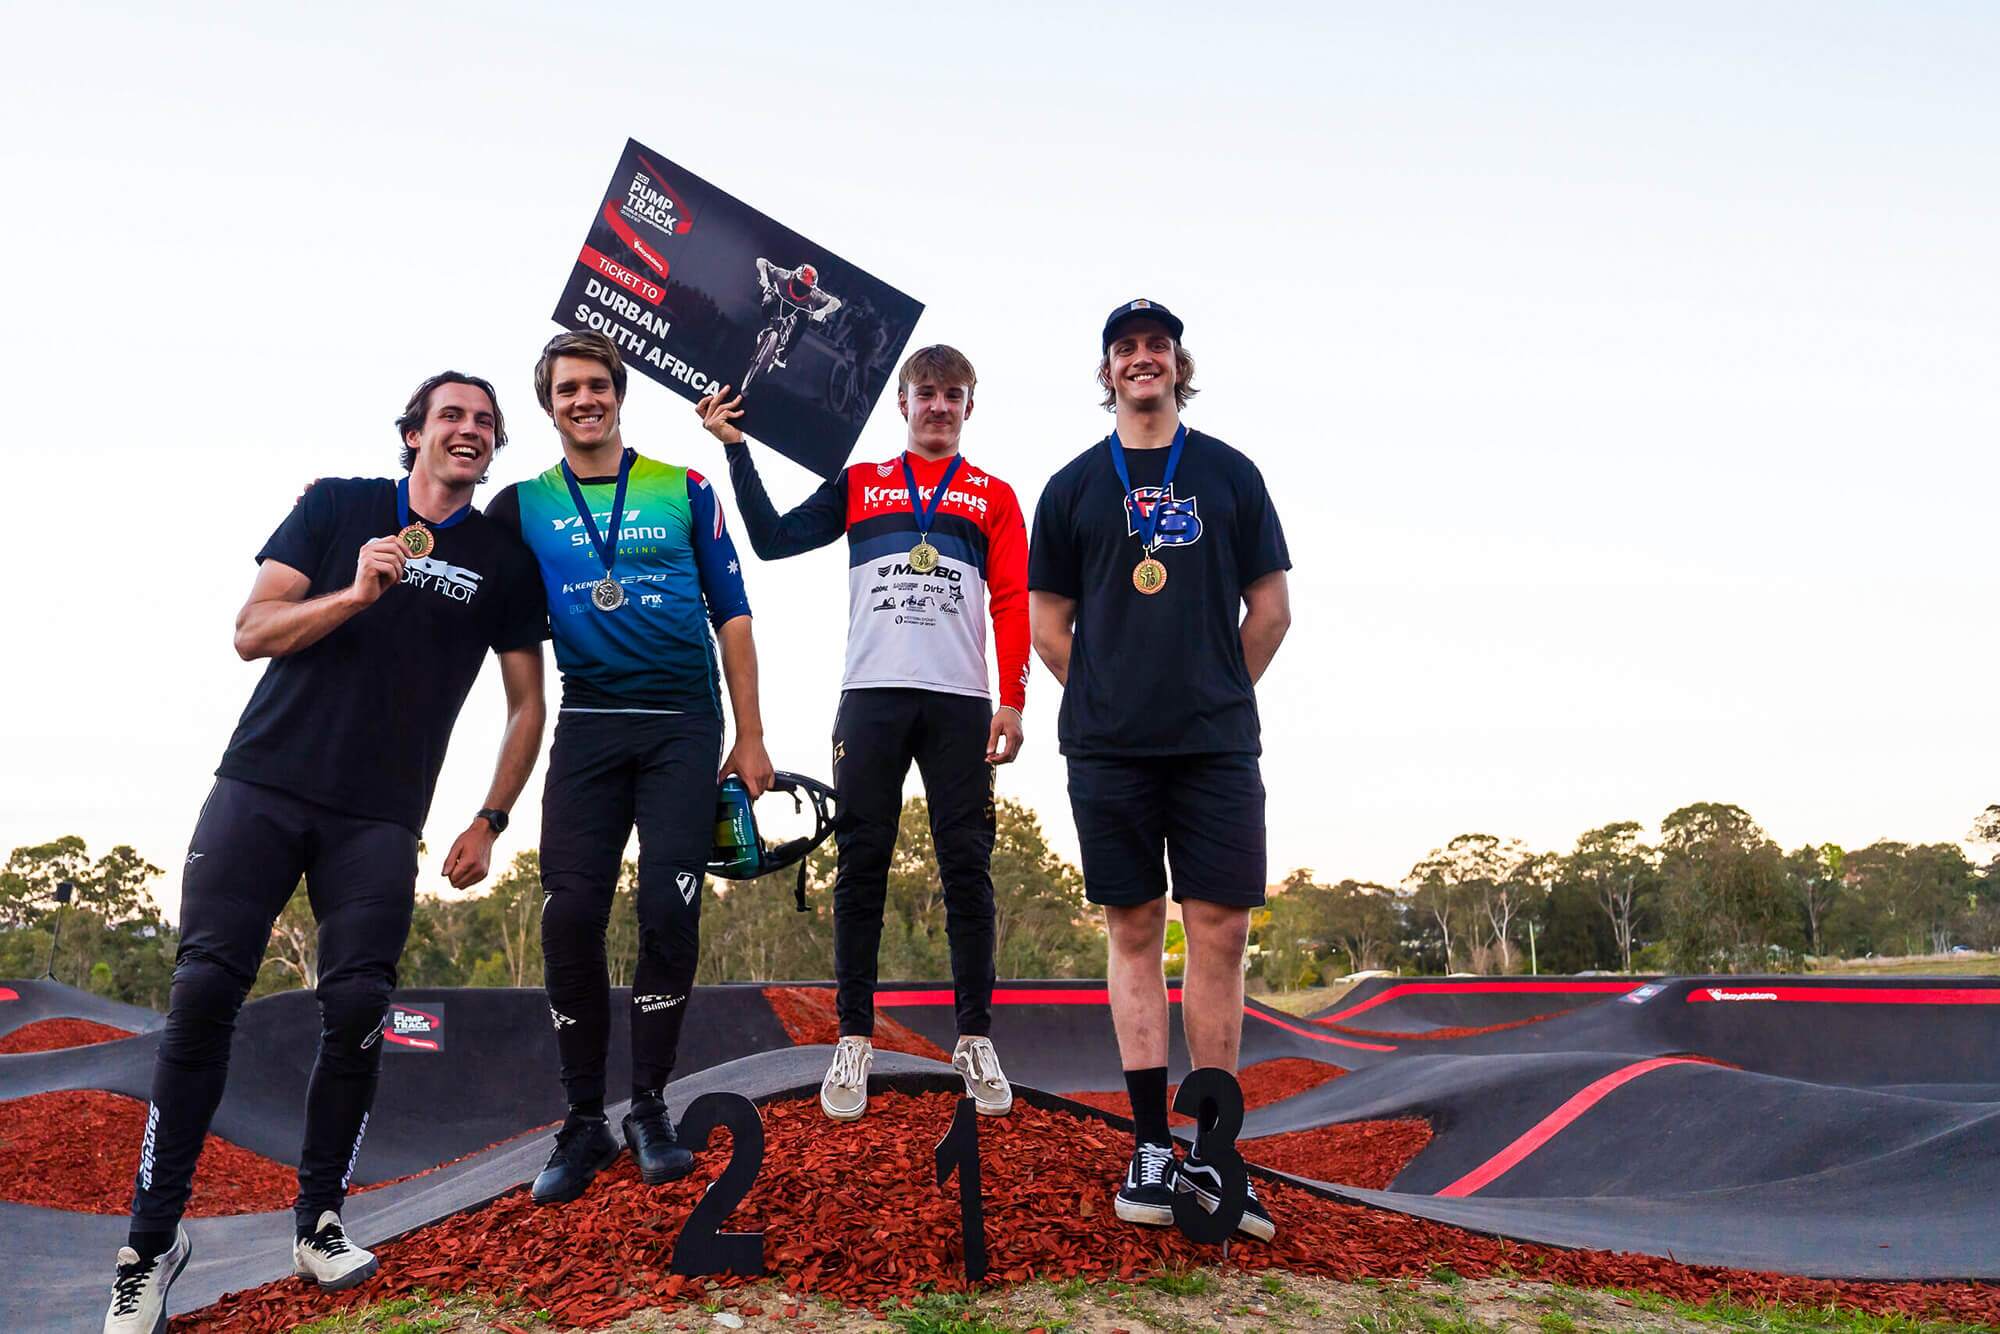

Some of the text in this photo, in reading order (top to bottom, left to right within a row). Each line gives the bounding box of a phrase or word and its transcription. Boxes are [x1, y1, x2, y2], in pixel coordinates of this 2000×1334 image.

[627, 192, 678, 231] TRACK
[629, 180, 674, 210] PUMP
[599, 257, 658, 299] TICKET TO
[584, 278, 671, 340] DURBAN
[574, 304, 721, 398] SOUTH AFRICA
[863, 500, 985, 520] INDURIES
[619, 546, 657, 555] ACING
[434, 577, 476, 604] PILOT
[575, 580, 600, 591] KEND
[640, 594, 663, 606] FOX
[394, 1021, 431, 1030] TRACK
[1171, 1067, 1245, 1245] 3
[671, 1091, 764, 1277] 2
[934, 1097, 987, 1282] 1
